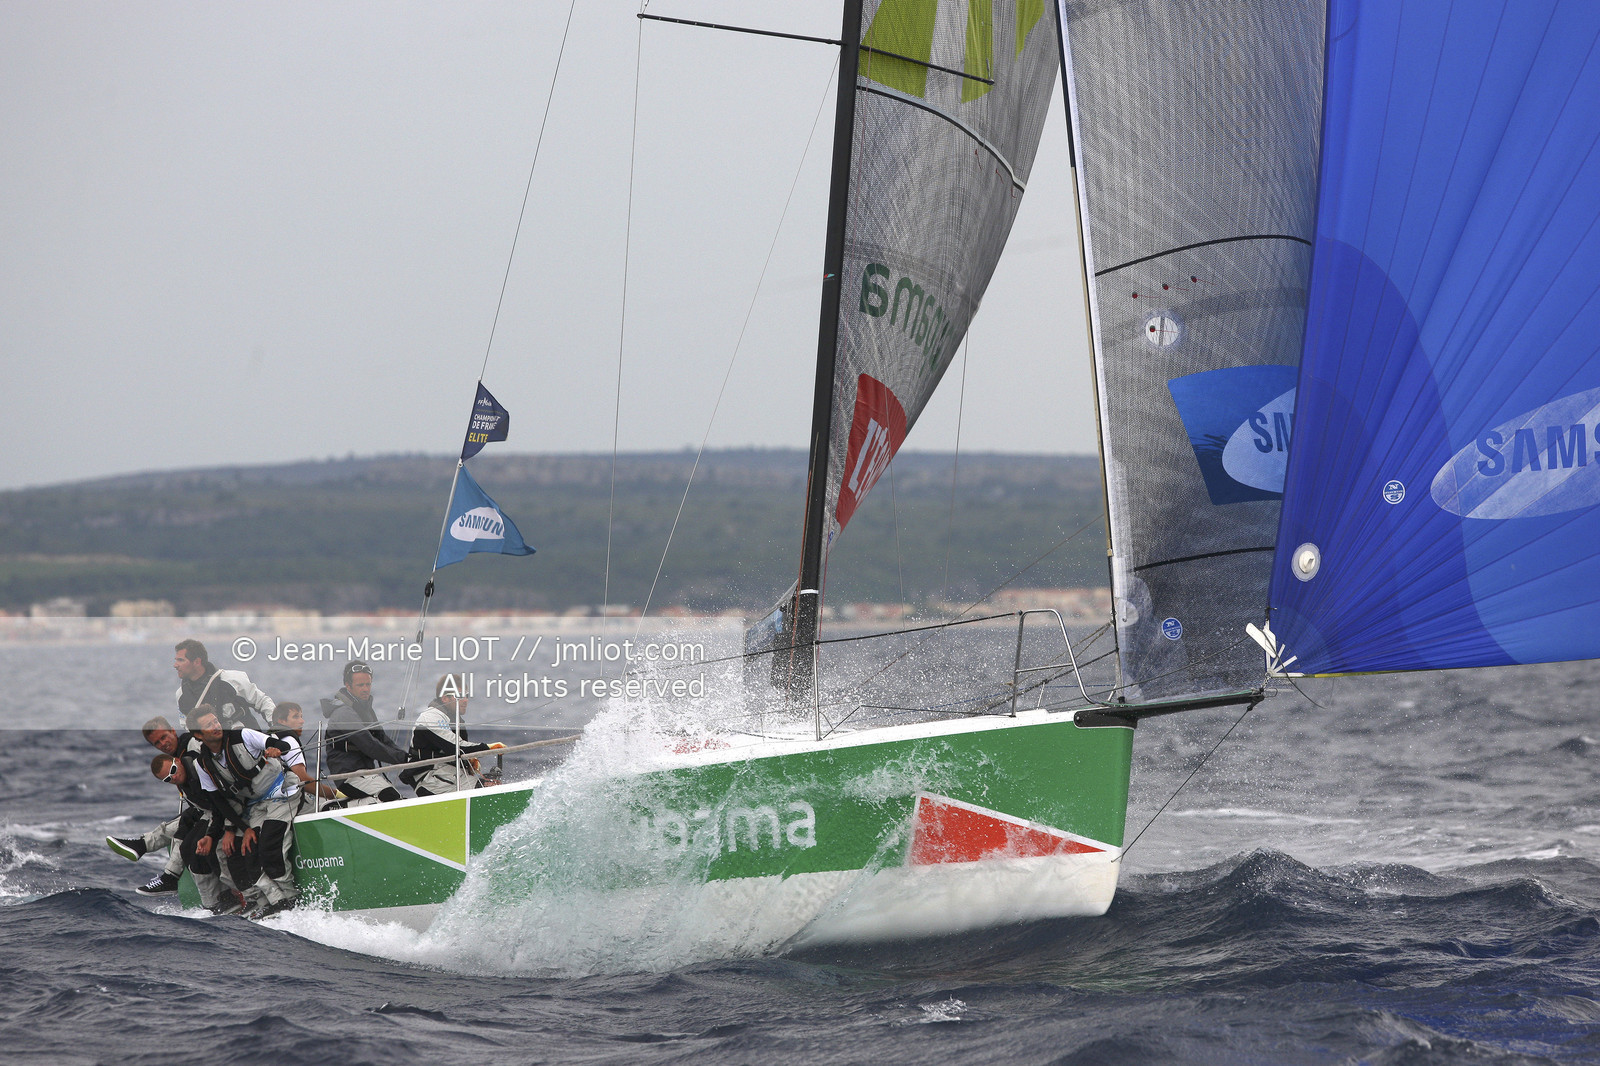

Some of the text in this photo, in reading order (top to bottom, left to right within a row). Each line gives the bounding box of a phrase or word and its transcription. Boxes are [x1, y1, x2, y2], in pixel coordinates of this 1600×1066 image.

[471, 420, 481, 429] DE
[1248, 412, 1294, 453] SA
[468, 432, 489, 443] ELITE
[1476, 423, 1600, 477] SAM
[459, 513, 505, 537] SAMUN
[295, 854, 344, 871] Groupama
